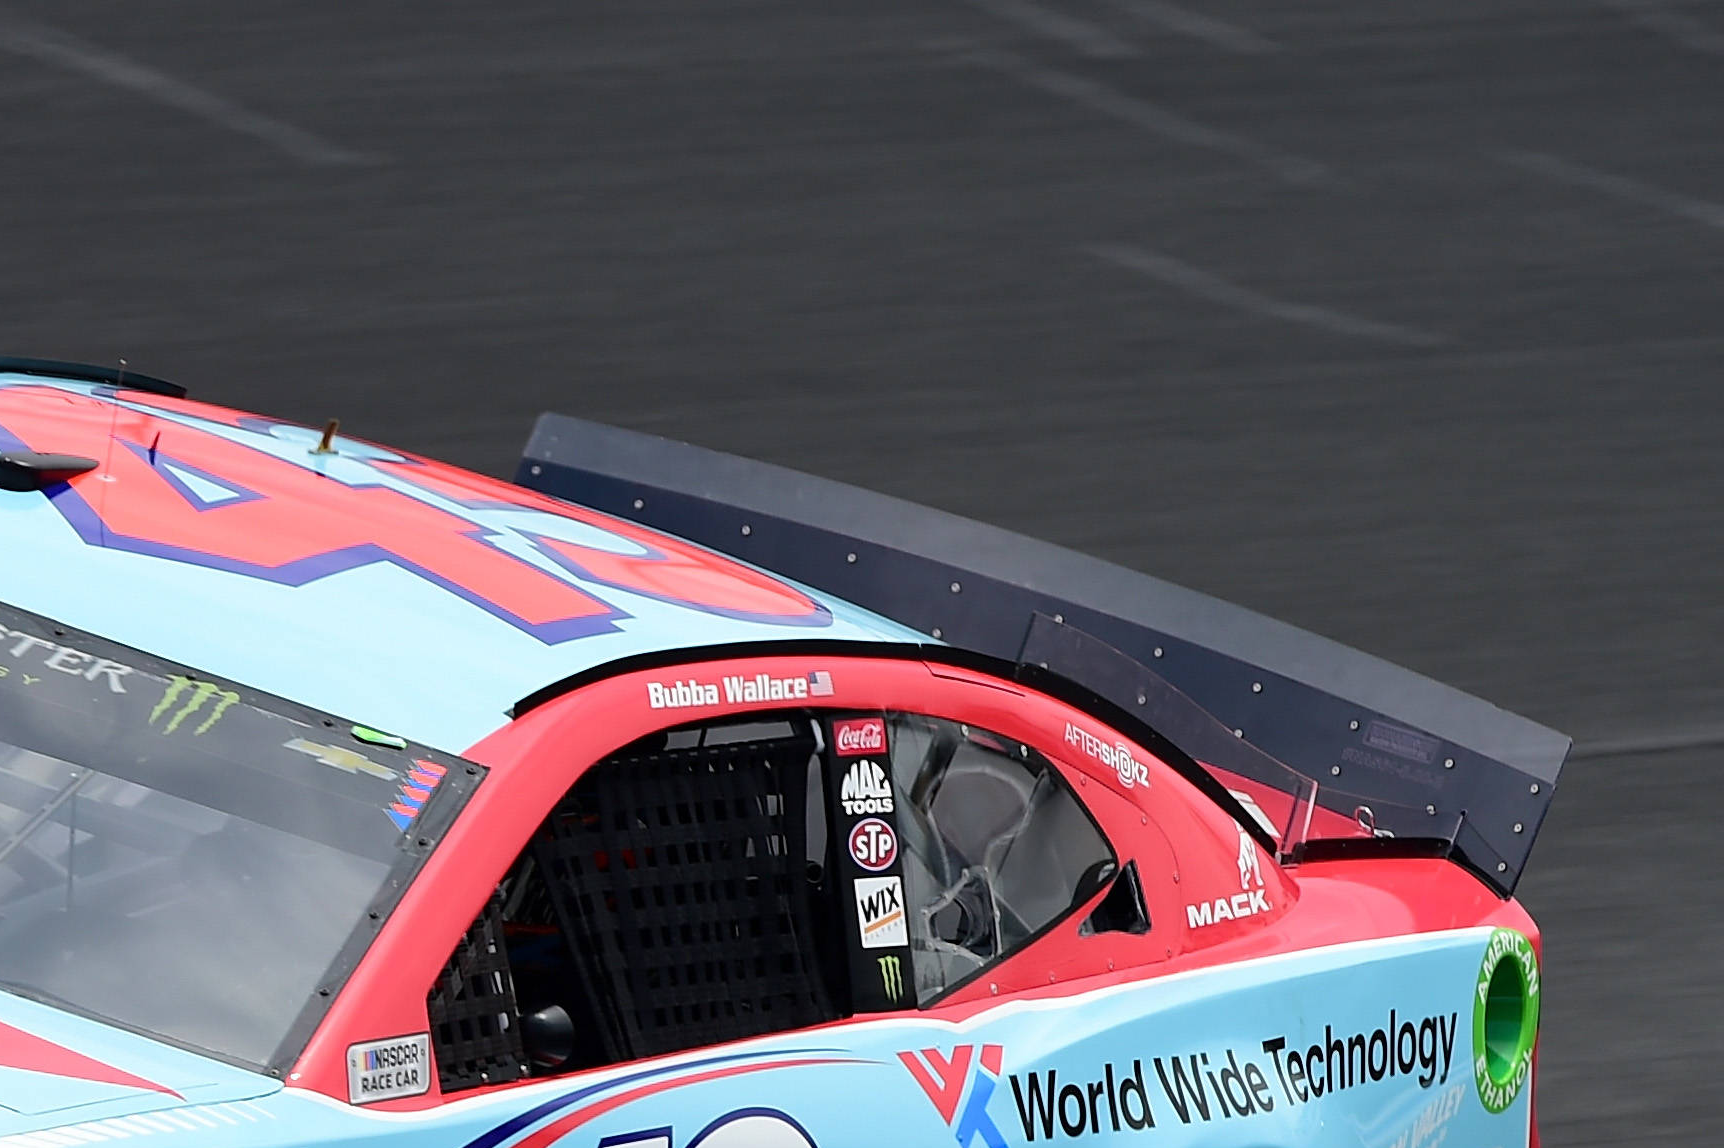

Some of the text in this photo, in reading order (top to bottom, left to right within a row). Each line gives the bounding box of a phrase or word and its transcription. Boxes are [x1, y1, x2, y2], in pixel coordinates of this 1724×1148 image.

[647, 674, 808, 709] Bubba Wallace
[841, 759, 892, 800] MAC
[842, 798, 894, 815] TOOLS
[855, 824, 893, 864] STP
[860, 882, 900, 923] WIX
[1187, 889, 1270, 929] MACK
[1478, 931, 1539, 1005] AMERICAN
[374, 1043, 419, 1069] NASCAR
[1010, 1009, 1459, 1142] World Wide Technology
[361, 1069, 420, 1093] RACE CAR
[1476, 1047, 1532, 1109] ETHANOL
